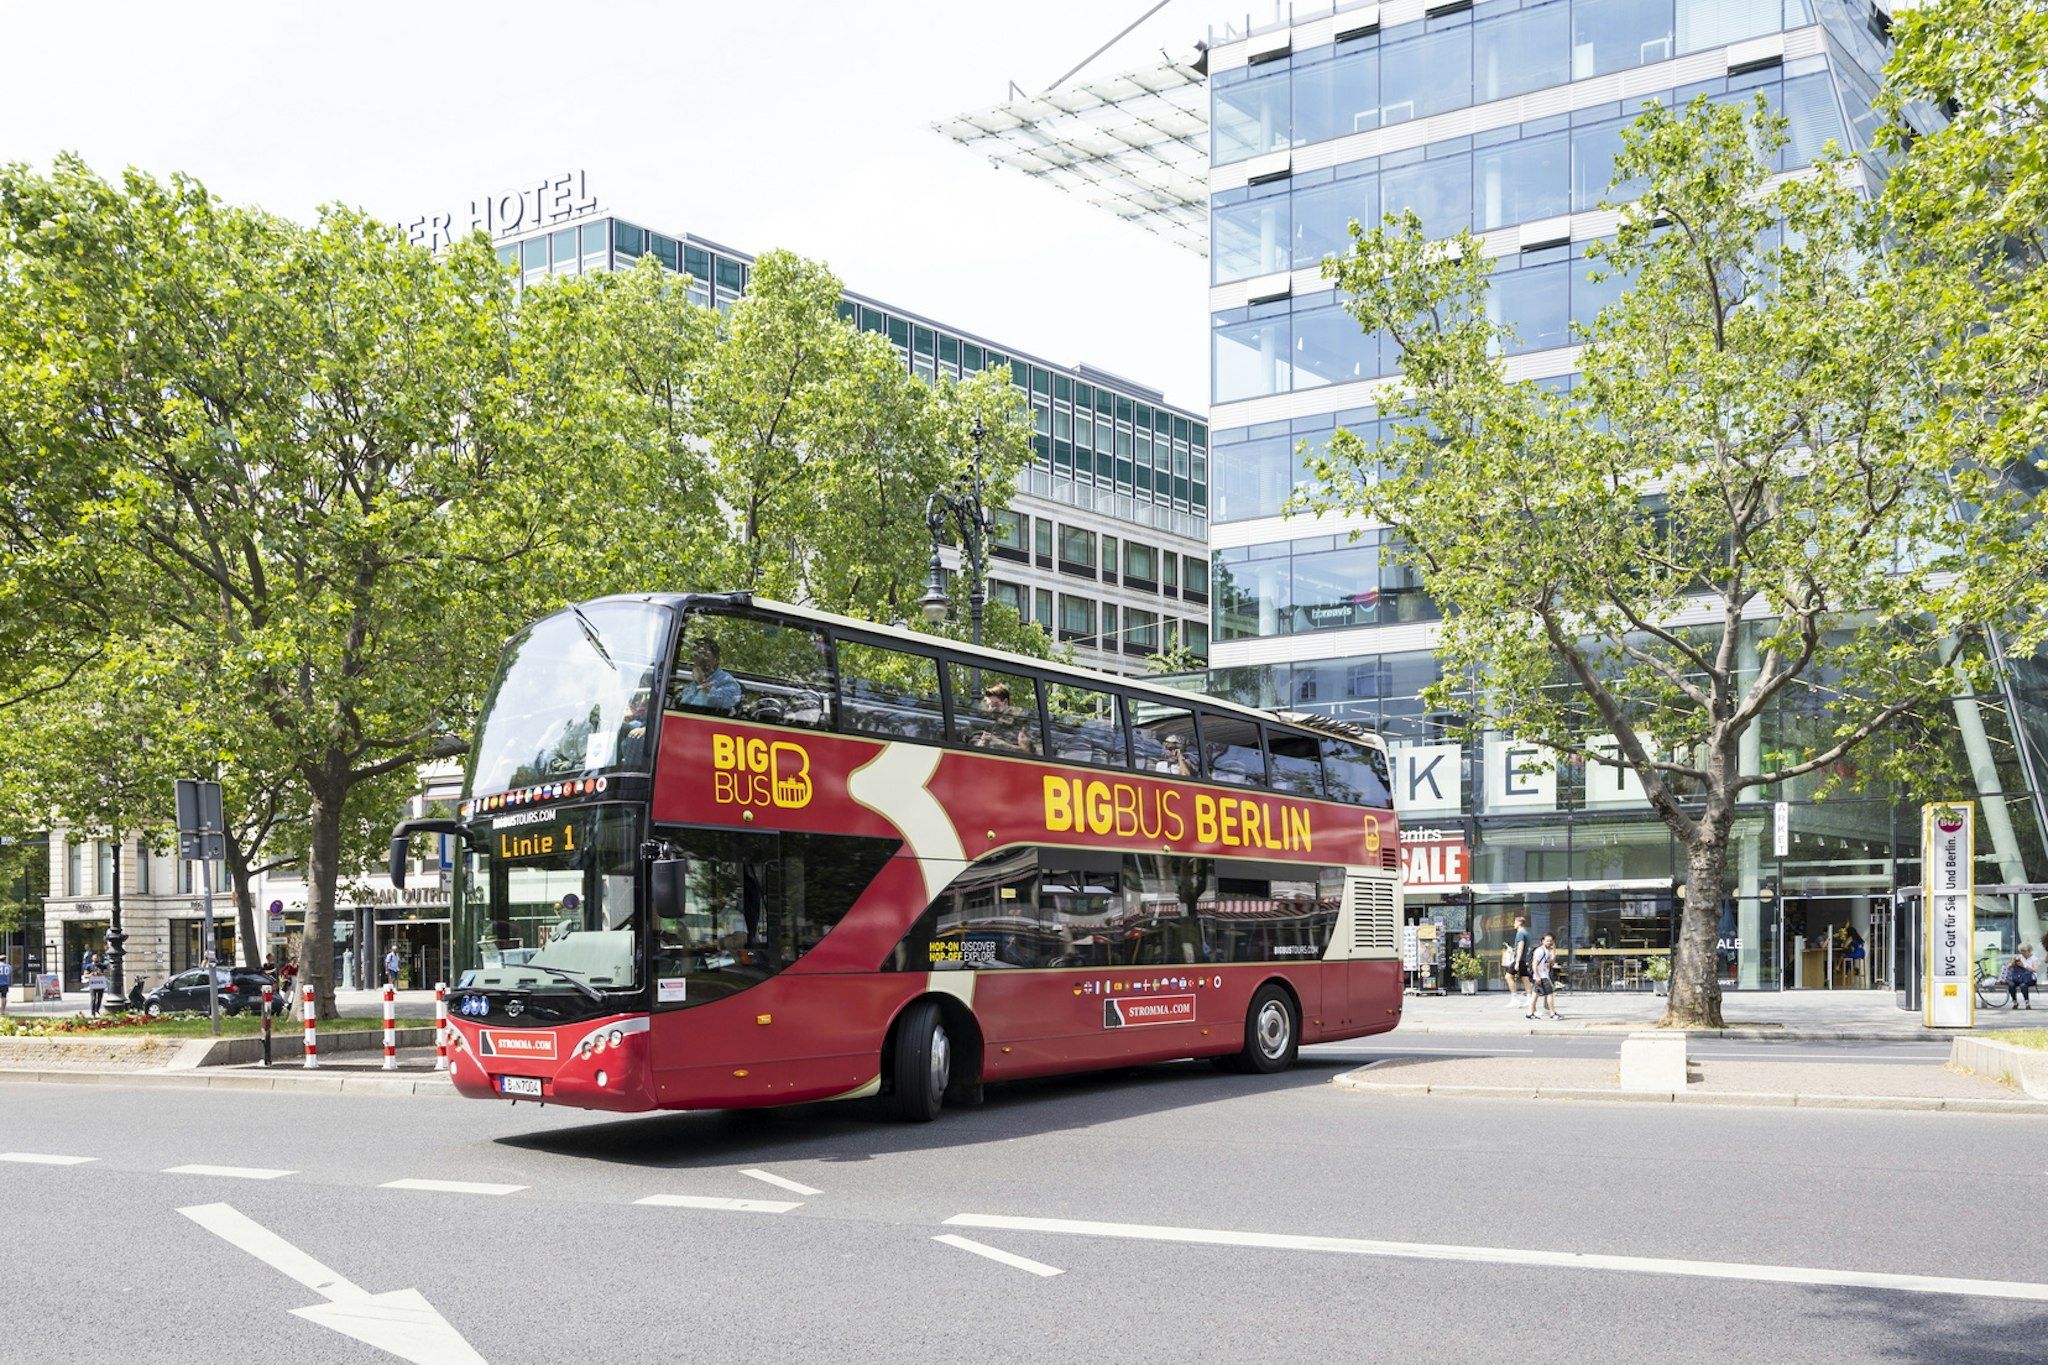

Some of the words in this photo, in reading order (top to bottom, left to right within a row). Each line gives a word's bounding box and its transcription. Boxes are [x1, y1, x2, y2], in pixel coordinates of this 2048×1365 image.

[396, 210, 452, 254] ER
[464, 168, 597, 237] HOTEL
[713, 733, 769, 773] BIG
[715, 771, 771, 806] BUS
[492, 809, 556, 829] BIGBUSTOURS.COM
[1195, 794, 1312, 852] BERLIN
[1777, 804, 1786, 854] ARKET
[501, 833, 553, 858] Linie
[564, 824, 575, 851] 1
[1945, 836, 1956, 867] Berlin.
[1945, 870, 1956, 890] Und
[1944, 913, 1956, 928] für
[929, 941, 960, 952] HOP-ON
[961, 941, 996, 952] DISCOVER
[929, 951, 963, 962] HOP-OFF
[964, 951, 996, 961] EXPLORE
[1129, 1003, 1190, 1017] STROMMA.COM
[498, 1039, 552, 1051] STROMMA.COM
